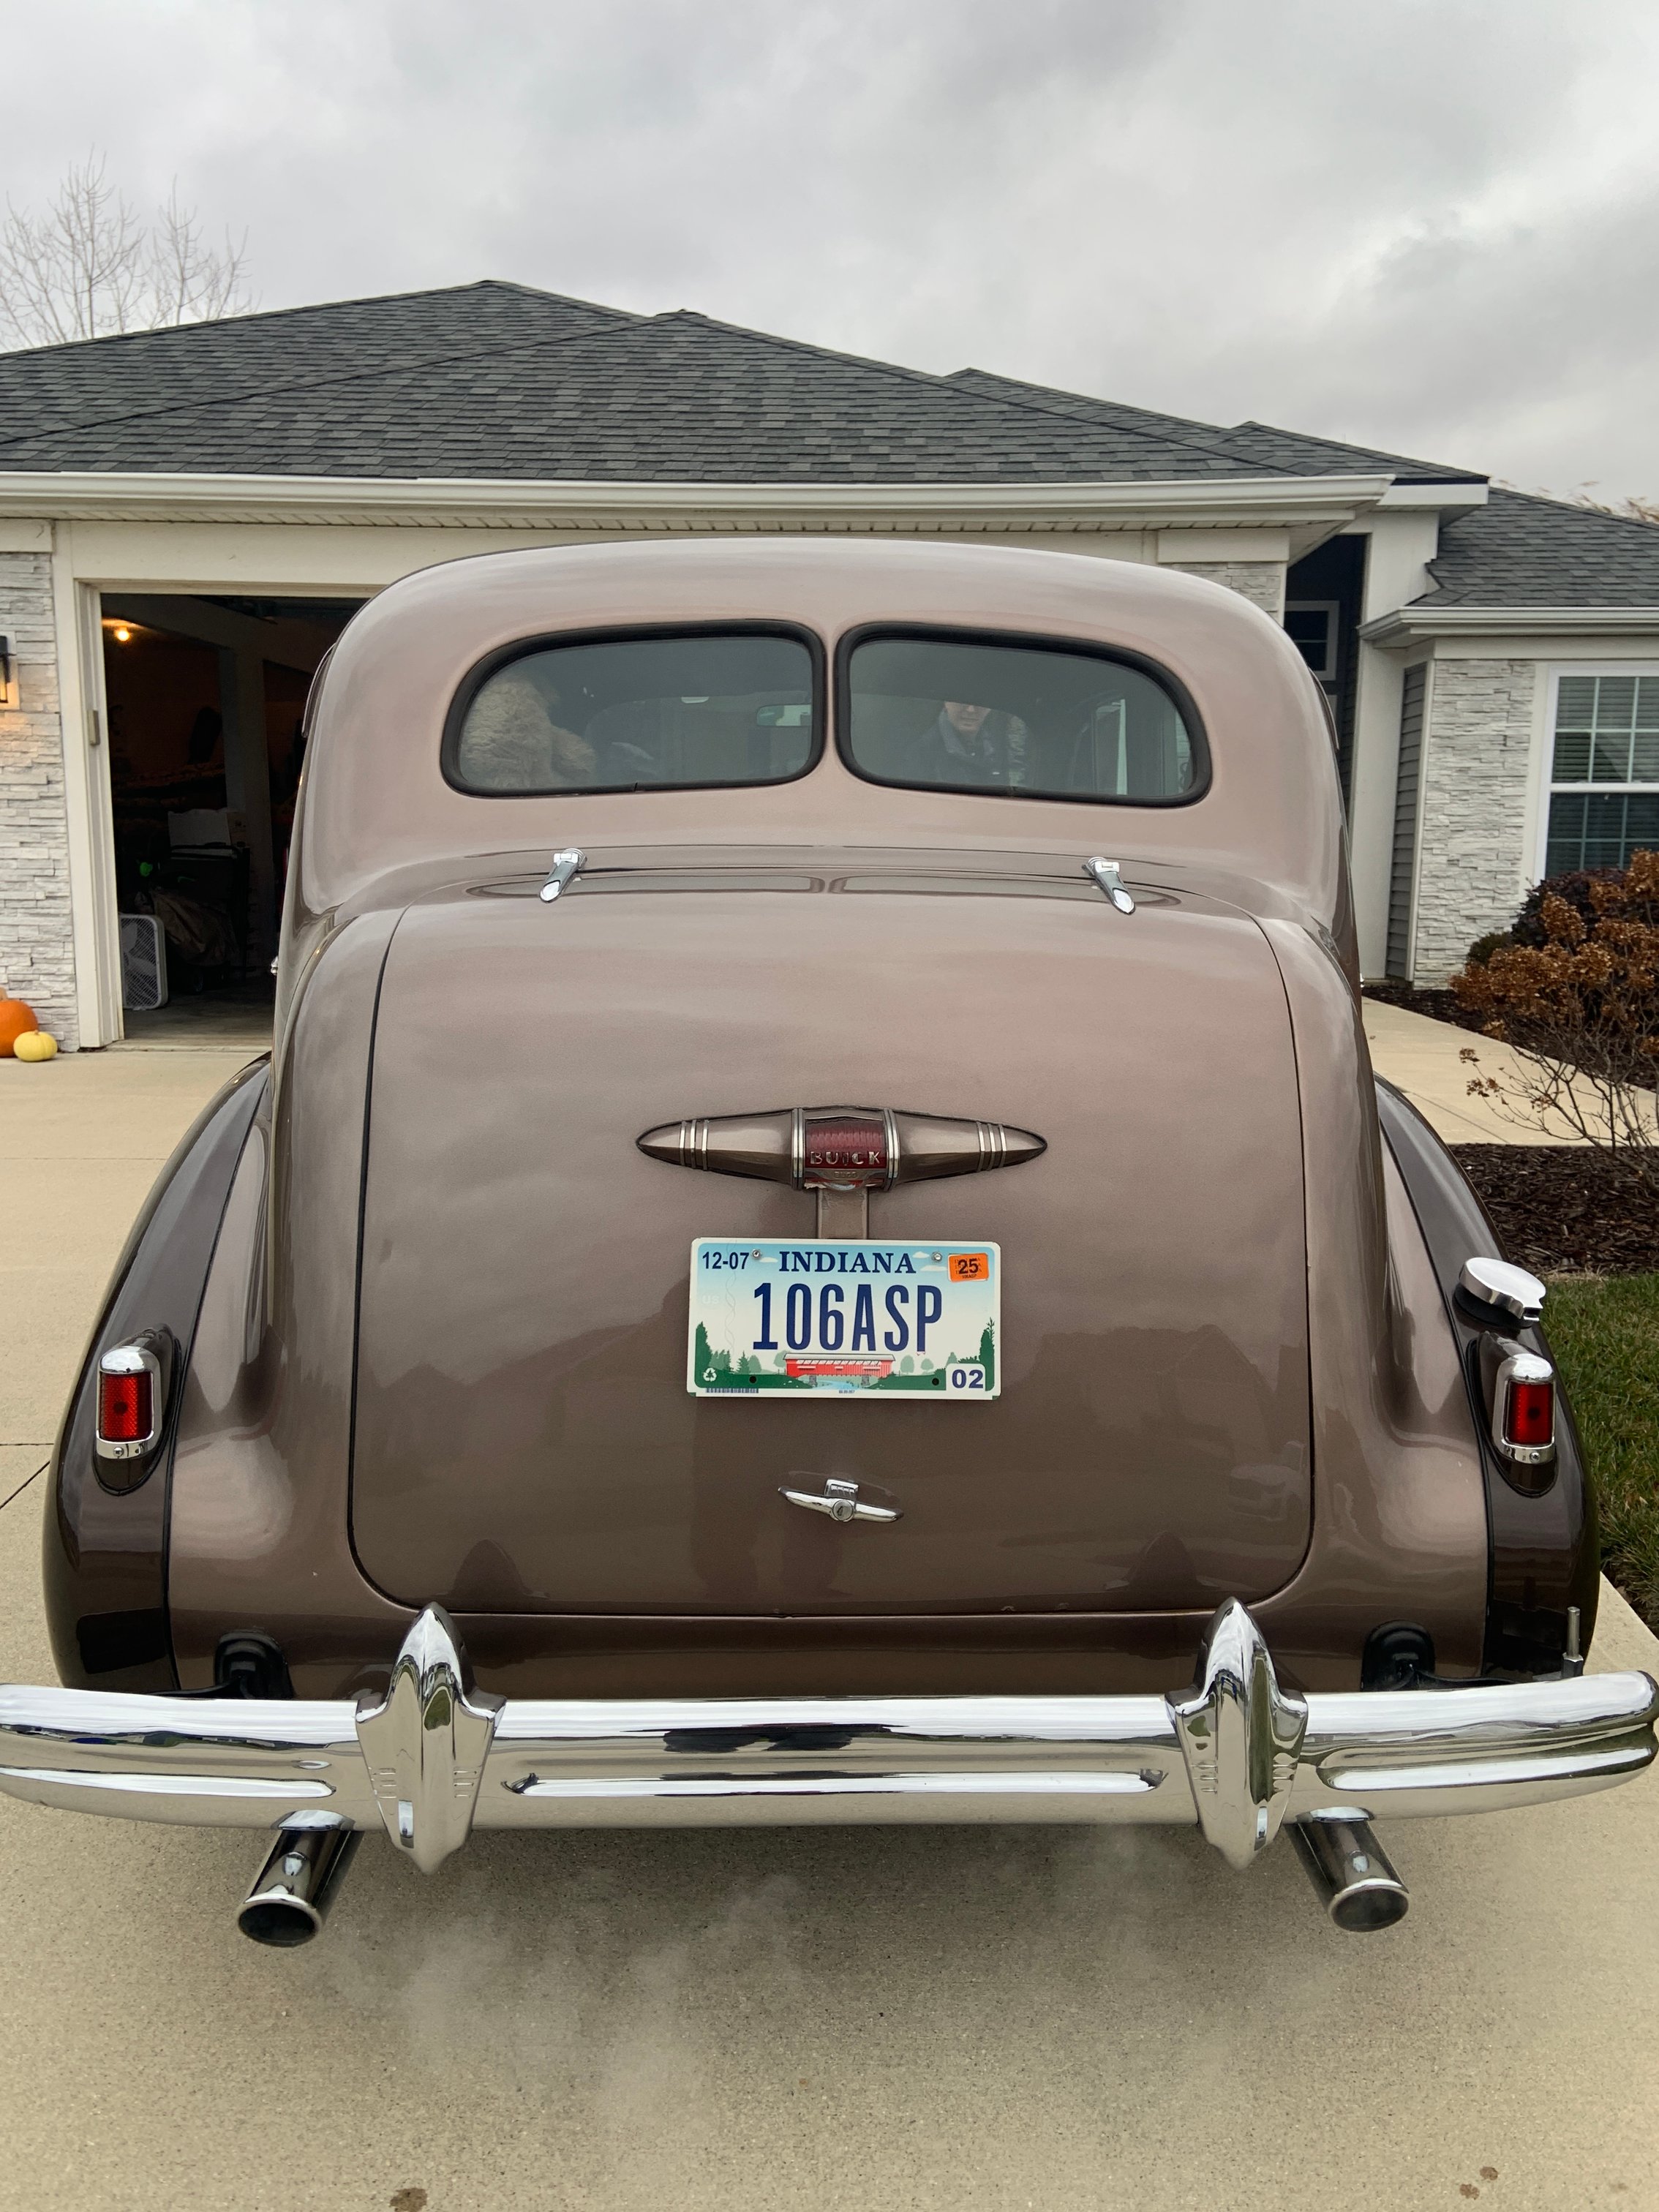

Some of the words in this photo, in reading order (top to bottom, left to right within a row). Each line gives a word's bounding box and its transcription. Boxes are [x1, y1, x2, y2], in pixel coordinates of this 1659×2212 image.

[810, 1151, 880, 1165] BUICK
[702, 1252, 750, 1269] 12-07
[778, 1251, 917, 1274] INDIANA
[958, 1257, 979, 1274] 25
[753, 1282, 942, 1352] 106ASP
[951, 1369, 984, 1389] 02
